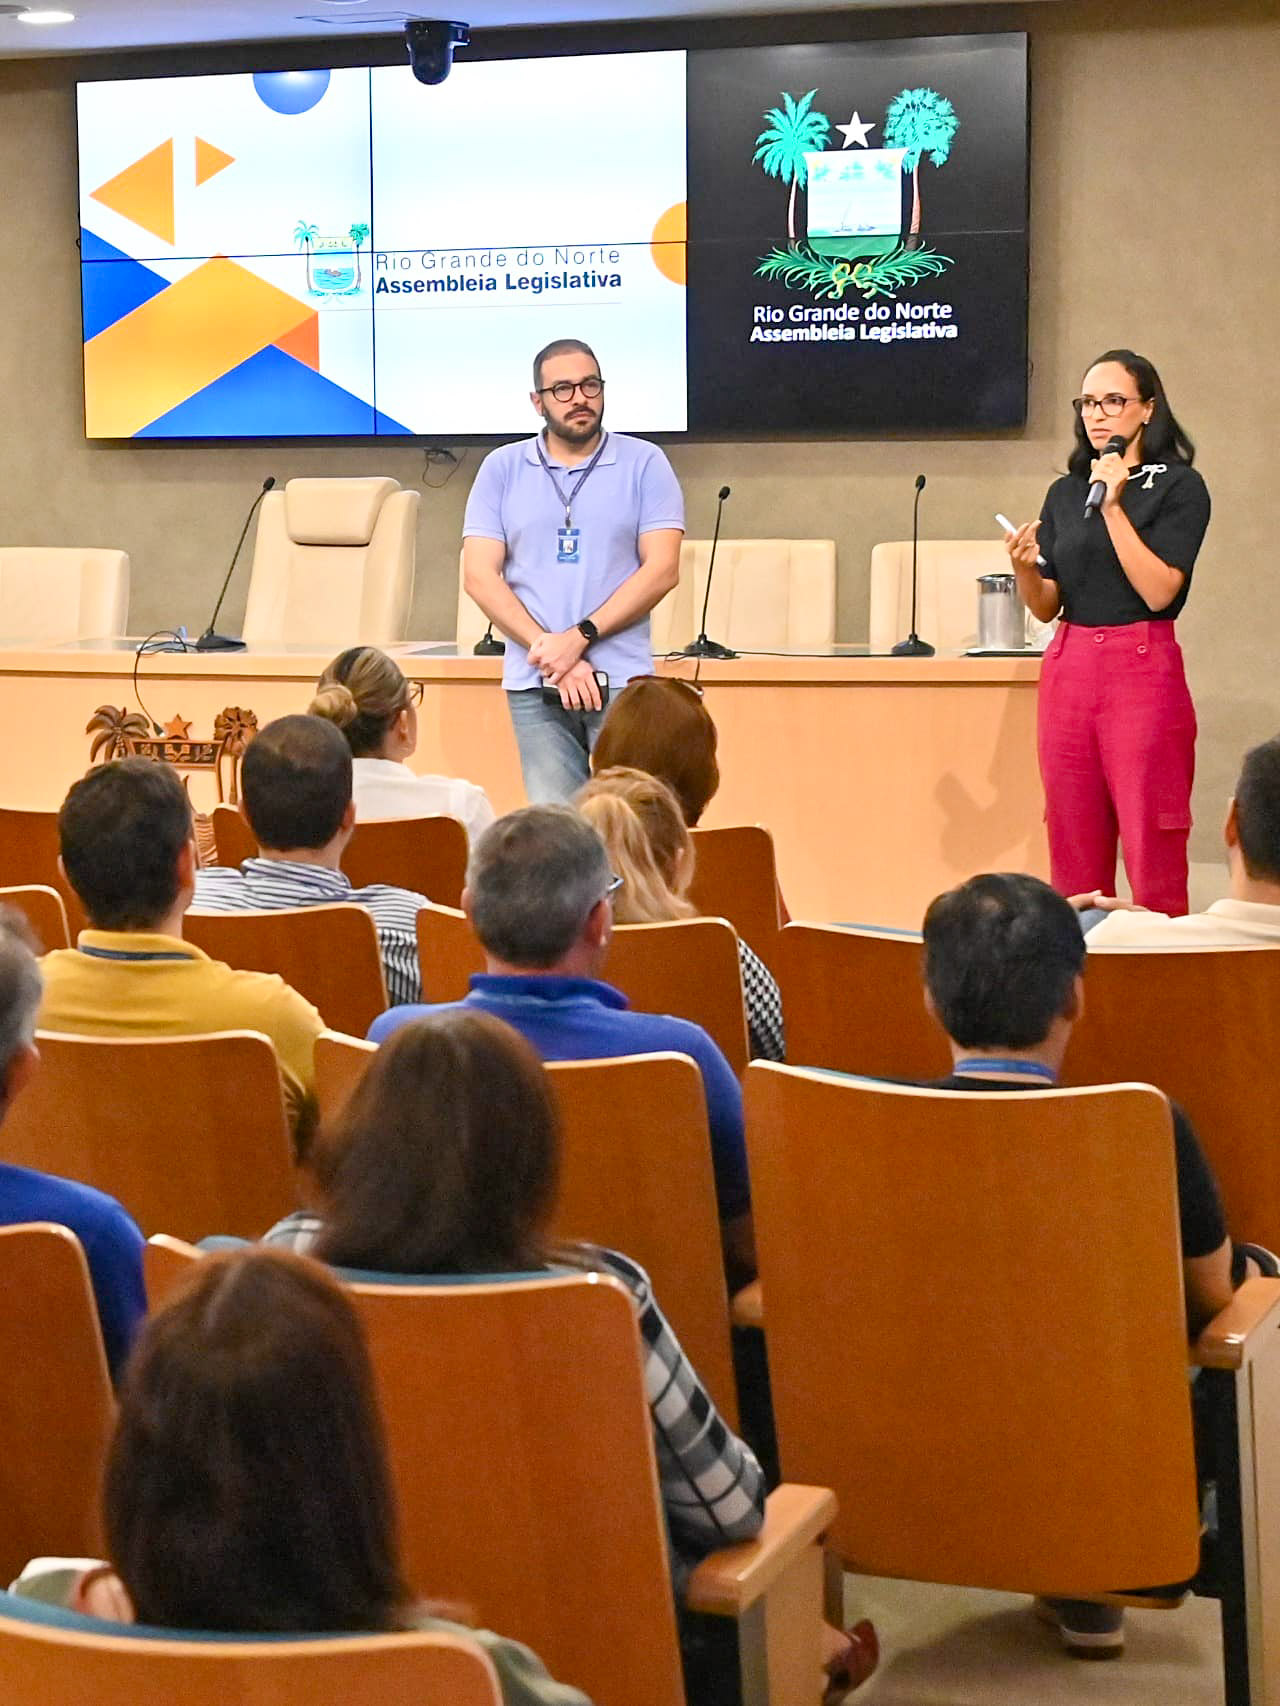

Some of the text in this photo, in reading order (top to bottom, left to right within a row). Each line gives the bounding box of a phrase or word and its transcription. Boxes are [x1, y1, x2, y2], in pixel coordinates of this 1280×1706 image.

[376, 247, 621, 271] Rio Grande do Norte
[375, 270, 622, 294] Assembleia Legislativa
[753, 302, 953, 323] Rio Grande do Norte
[749, 321, 958, 344] Assembleia Legislativa
